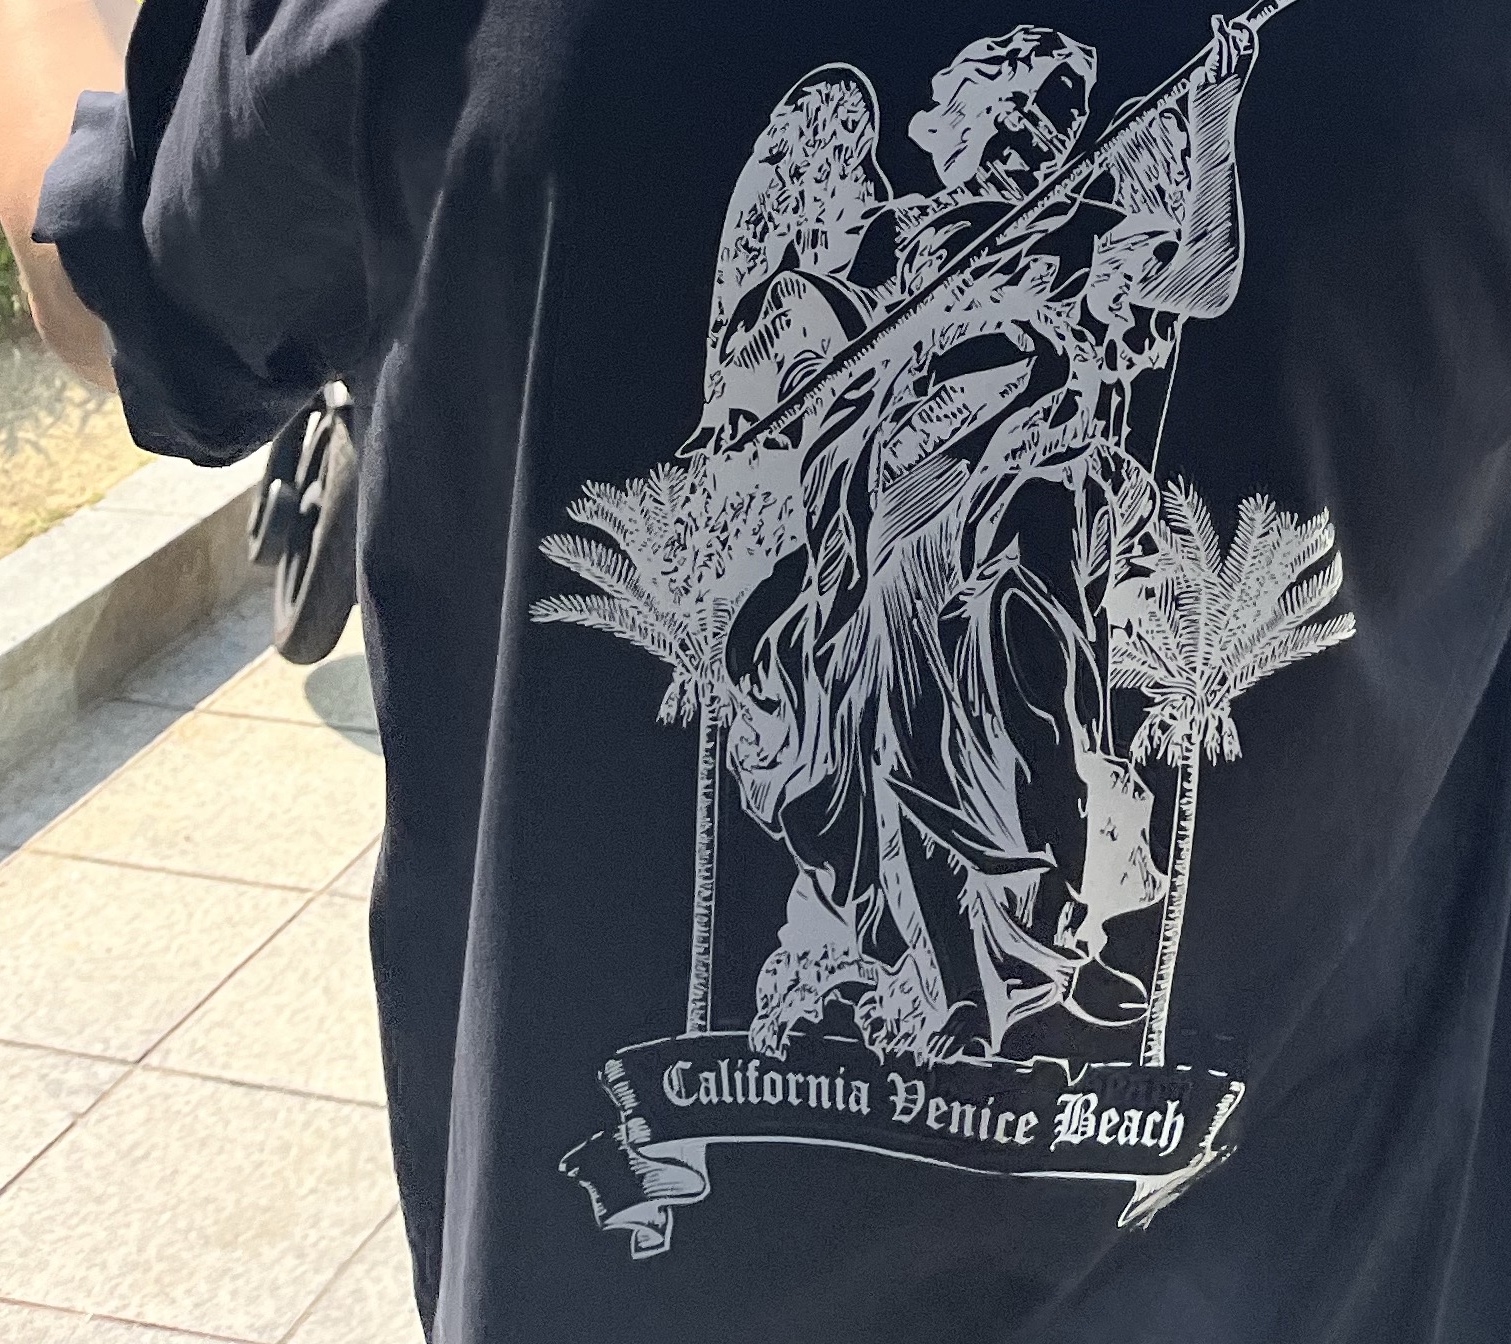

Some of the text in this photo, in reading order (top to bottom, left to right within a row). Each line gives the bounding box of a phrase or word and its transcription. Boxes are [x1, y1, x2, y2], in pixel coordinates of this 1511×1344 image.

[662, 1058, 1186, 1158] California Venice Beach
